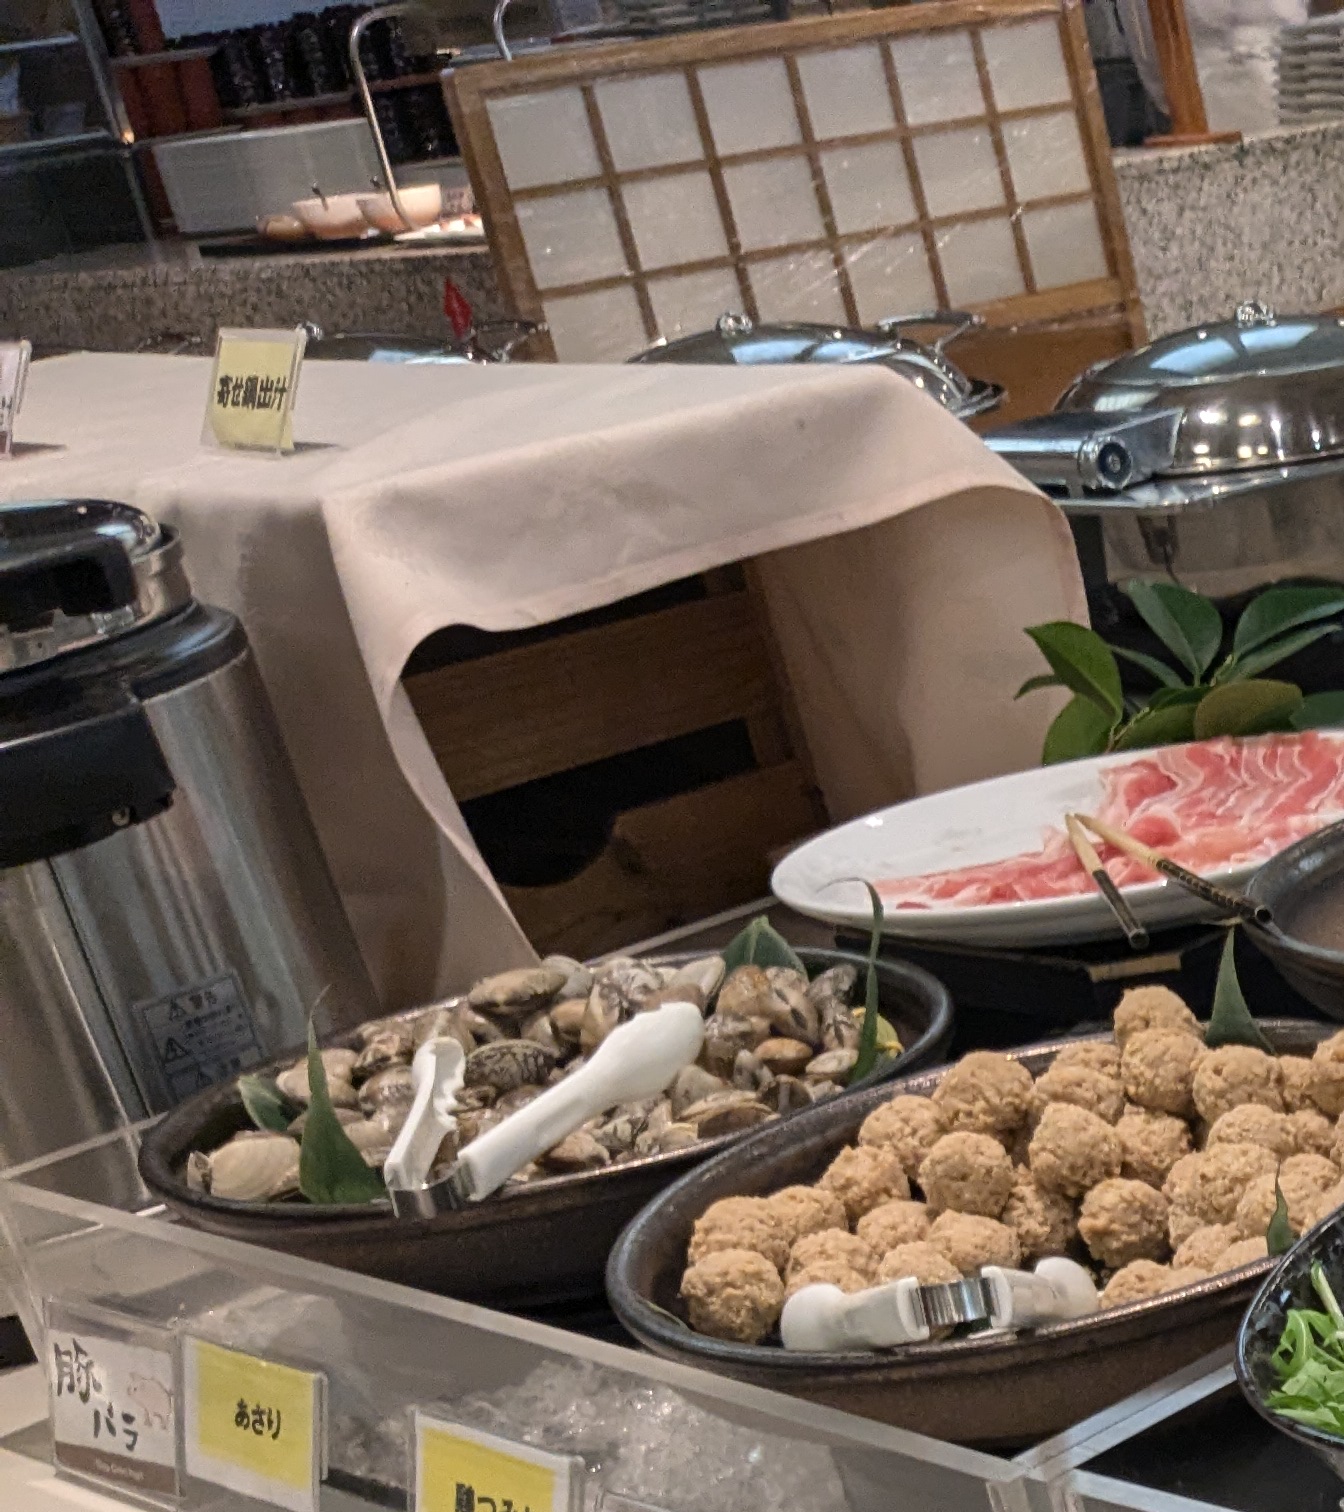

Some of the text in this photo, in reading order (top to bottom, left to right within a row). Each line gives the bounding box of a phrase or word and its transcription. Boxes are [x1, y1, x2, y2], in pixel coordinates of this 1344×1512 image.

[93, 1401, 139, 1452] バラ
[234, 1398, 282, 1440] あさり
